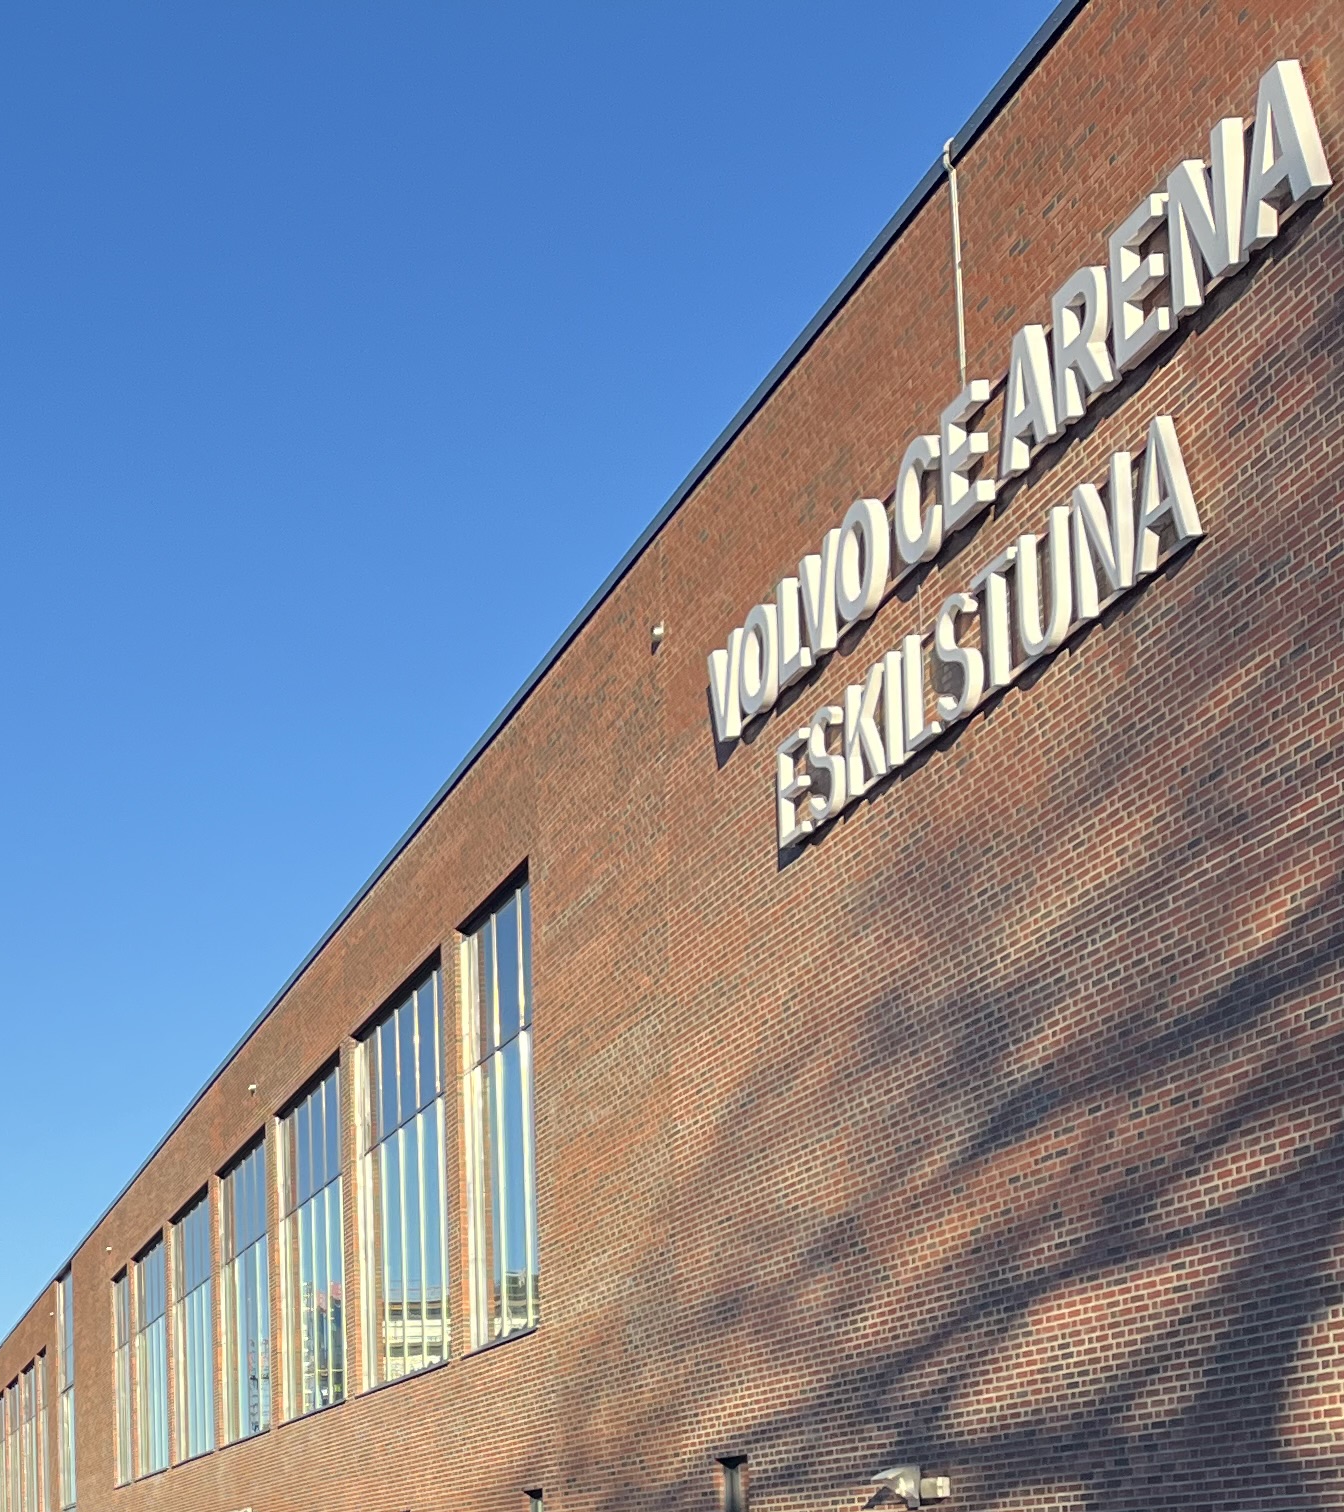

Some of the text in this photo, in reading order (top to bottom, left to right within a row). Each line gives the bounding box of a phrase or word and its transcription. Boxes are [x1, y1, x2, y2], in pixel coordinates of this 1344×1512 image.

[707, 59, 1332, 743] VOLVO CE ARENA
[777, 415, 1203, 849] ESKILSTUNA
